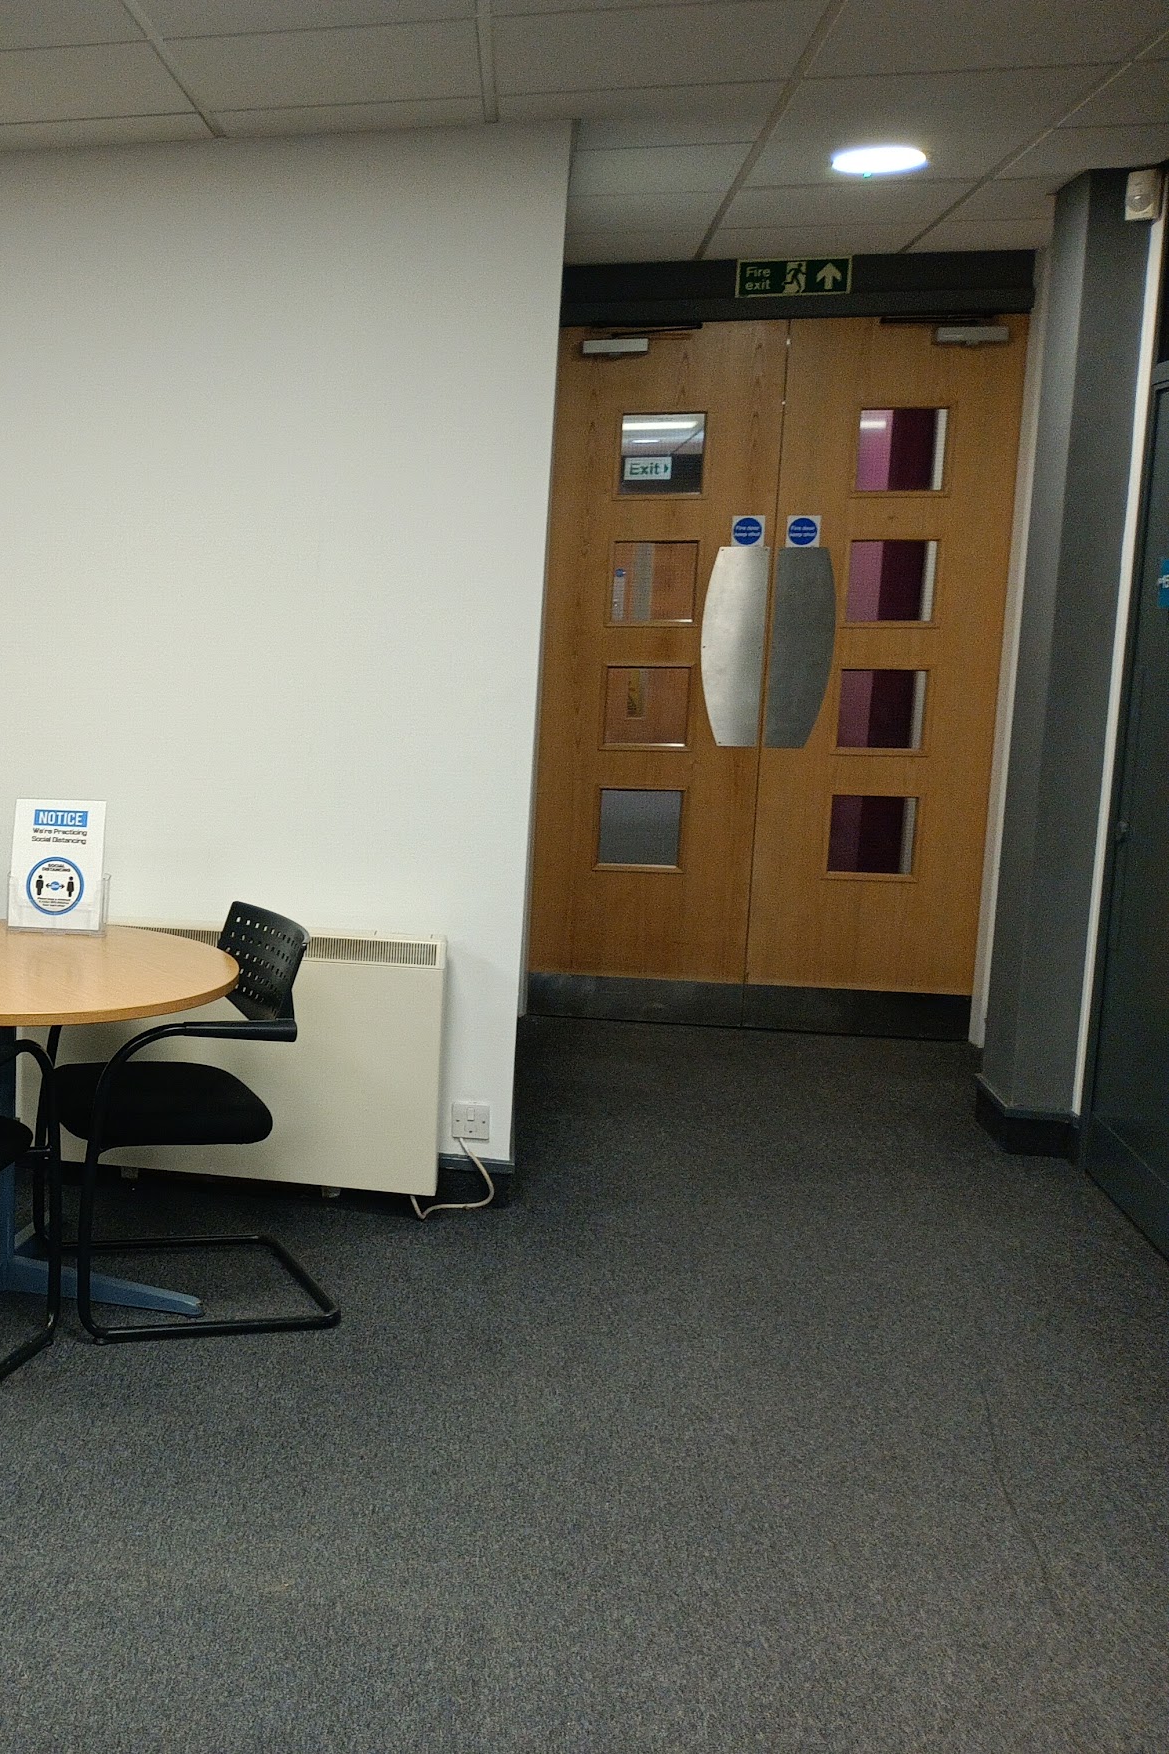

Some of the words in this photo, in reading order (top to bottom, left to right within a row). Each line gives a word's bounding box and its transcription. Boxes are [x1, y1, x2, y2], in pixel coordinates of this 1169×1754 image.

[745, 266, 771, 278] Fire
[744, 280, 771, 291] exit
[629, 463, 660, 476] Exit
[38, 811, 83, 826] NOTICE
[33, 827, 52, 835] We're
[52, 837, 87, 845] Distancing
